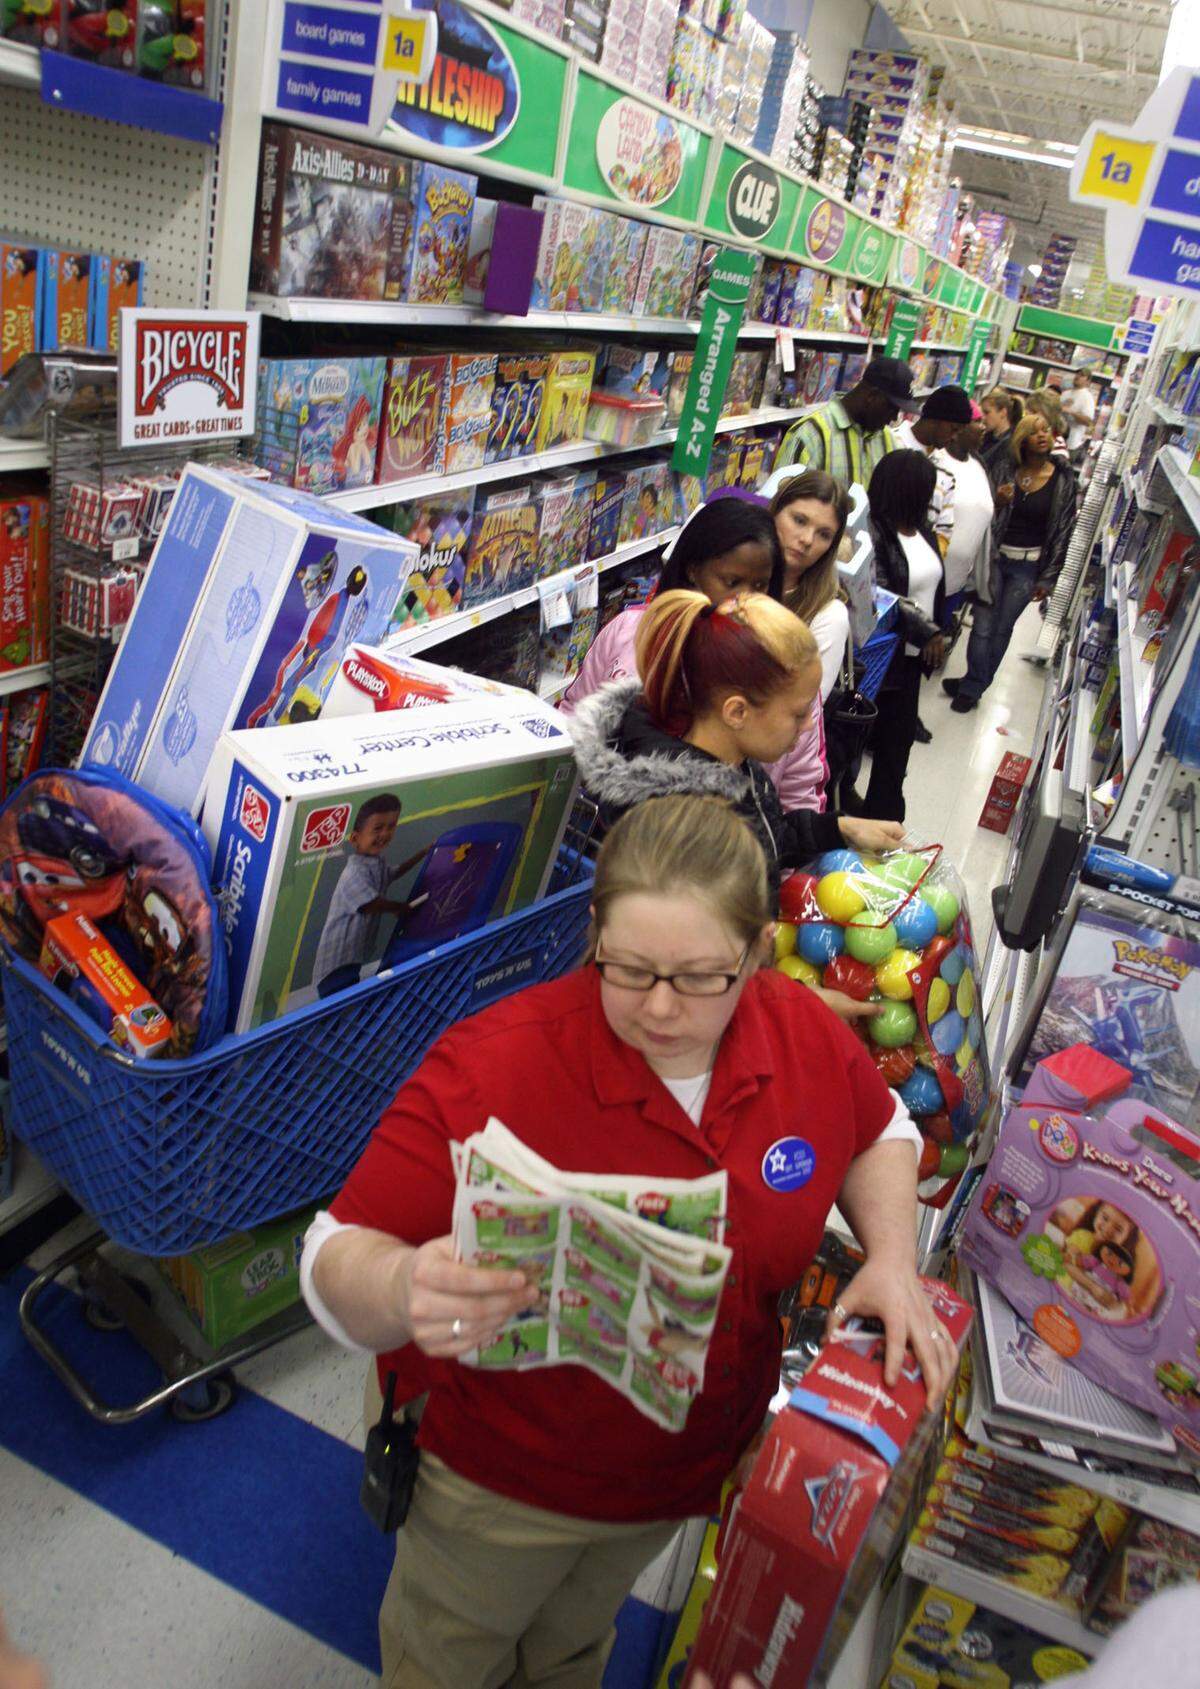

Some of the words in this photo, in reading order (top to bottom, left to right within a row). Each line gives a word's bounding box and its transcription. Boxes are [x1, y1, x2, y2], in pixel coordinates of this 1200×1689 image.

[295, 20, 328, 40] board
[328, 28, 366, 47] games
[393, 31, 415, 58] 1a
[286, 78, 320, 103] family
[321, 86, 362, 107] games
[1100, 152, 1133, 185] 1a
[736, 175, 780, 225] CLUE
[713, 269, 751, 287] GAMES
[141, 330, 242, 407] BICYCLE
[696, 307, 732, 413] Arranged
[134, 422, 161, 439] GREAT
[163, 421, 191, 437] CARDS
[195, 420, 221, 434] GREAT
[221, 416, 243, 431] TIMES
[686, 416, 706, 459] A-Z
[346, 661, 387, 699] PLAYSKOOL
[359, 732, 432, 756] Center
[431, 721, 512, 748] Scribble
[287, 765, 368, 783] 774300
[302, 807, 346, 850] STEP
